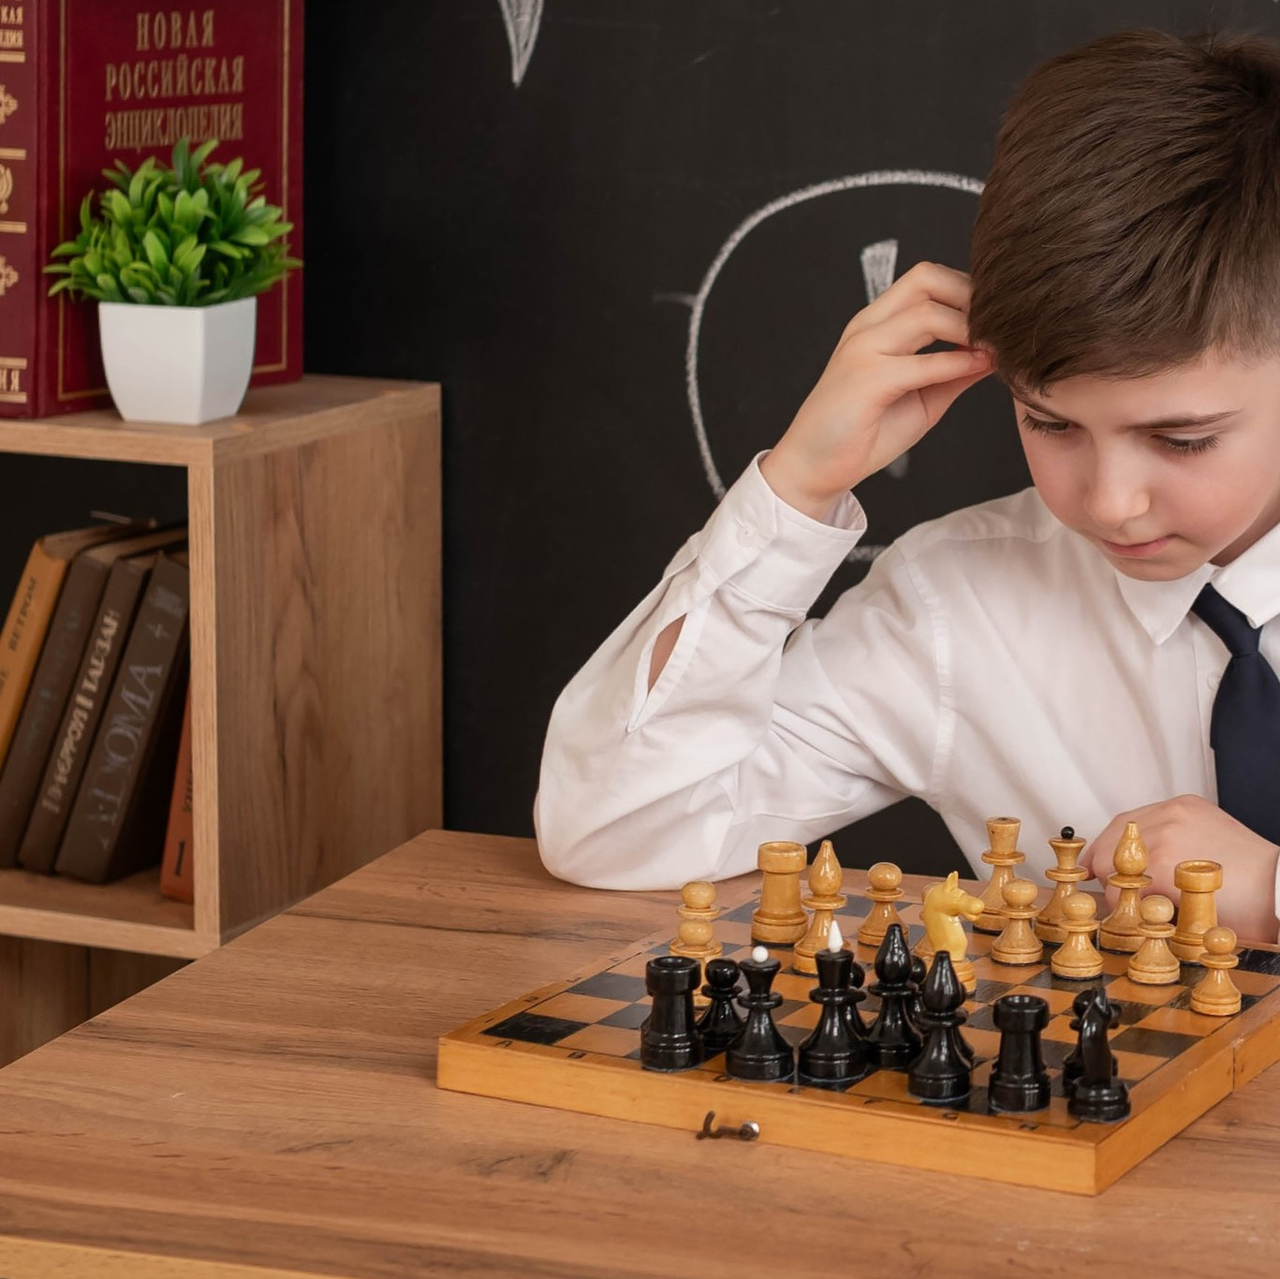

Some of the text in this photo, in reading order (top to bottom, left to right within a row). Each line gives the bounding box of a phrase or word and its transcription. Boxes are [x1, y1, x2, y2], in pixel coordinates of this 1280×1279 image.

[136, 9, 214, 52] НОВАЯ
[105, 53, 244, 102] РОССИЙСКАЯ
[105, 102, 244, 154] ЭНЦИКЛОПЕДИЯ
